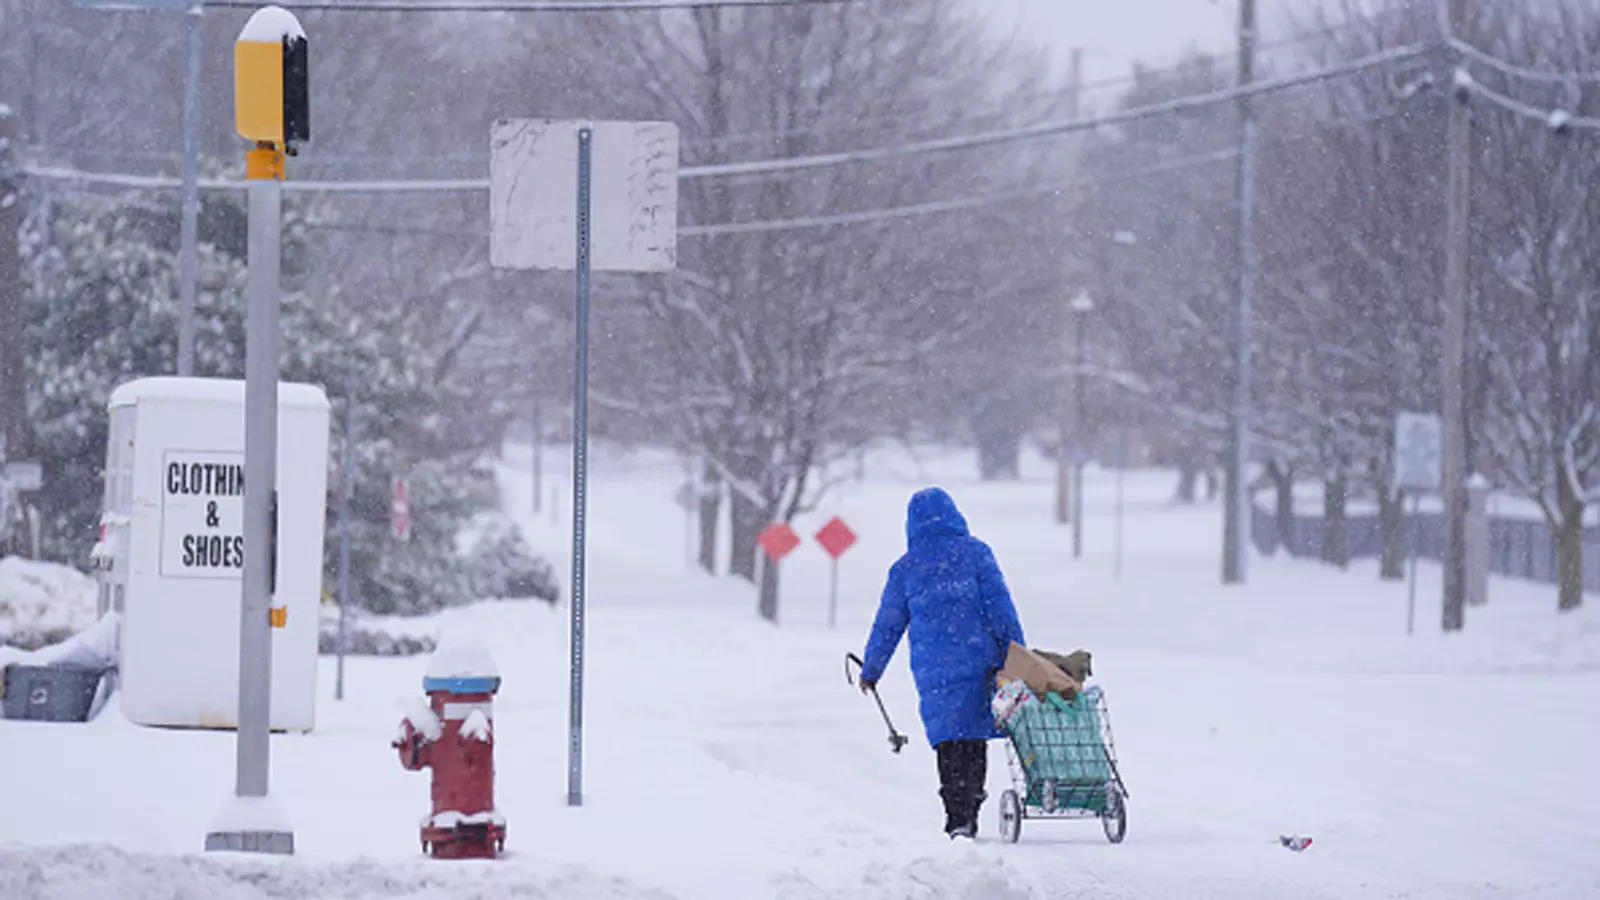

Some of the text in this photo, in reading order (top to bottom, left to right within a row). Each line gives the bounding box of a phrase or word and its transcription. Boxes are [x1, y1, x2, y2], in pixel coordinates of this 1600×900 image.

[167, 462, 246, 496] CLOTHIN
[206, 500, 220, 527] &
[182, 534, 244, 568] SHOES
